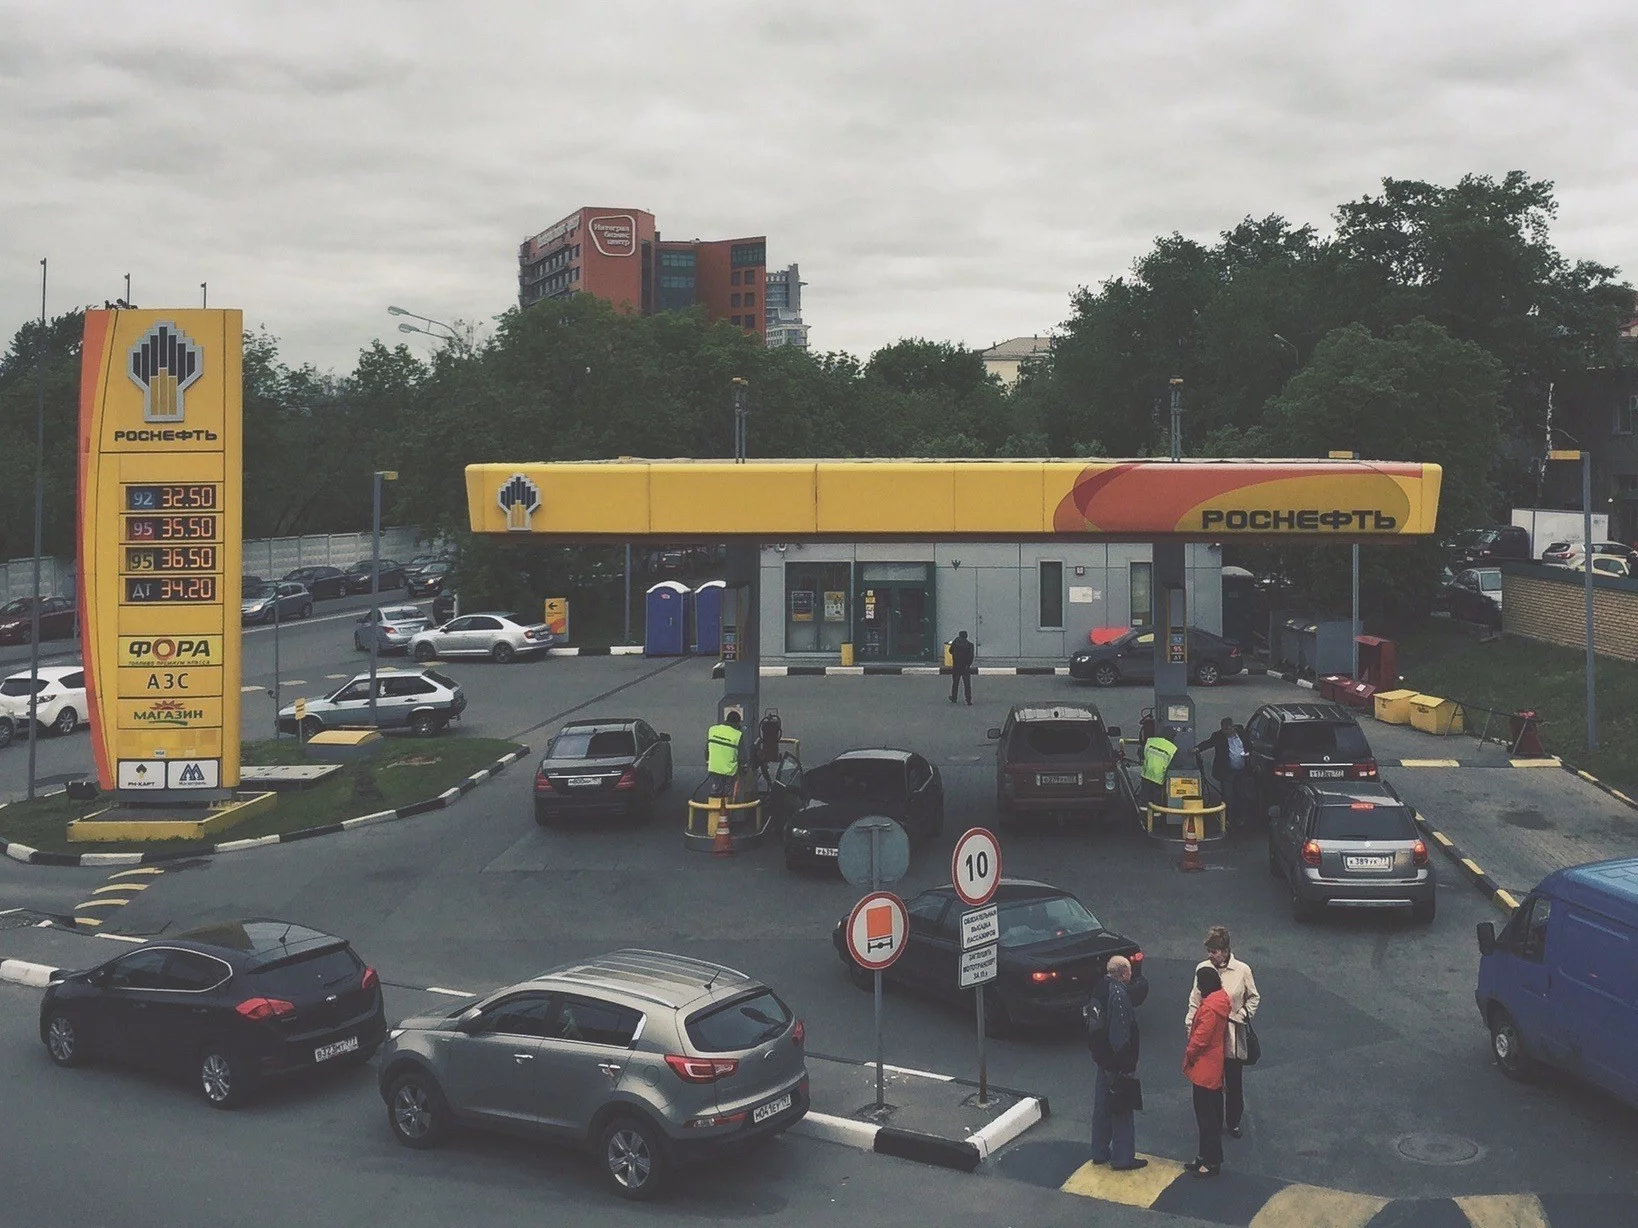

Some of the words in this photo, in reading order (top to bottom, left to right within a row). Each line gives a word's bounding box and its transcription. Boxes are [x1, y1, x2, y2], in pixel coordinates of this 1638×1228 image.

[603, 231, 630, 239] бизнес
[607, 239, 630, 247] центр
[114, 430, 218, 442] РОСНЕФТЬ
[133, 491, 153, 506] 92
[162, 487, 213, 507] 32.50
[133, 522, 153, 536] 95
[162, 518, 212, 538] 35.50
[1202, 509, 1397, 530] РОСНЕФТЬ
[131, 553, 153, 570] 95
[161, 548, 212, 568] 36.50
[161, 579, 212, 599] 34.20
[129, 637, 210, 660] ФОРА
[147, 672, 189, 690] АЗС
[133, 710, 203, 720] МАГАЗИН
[965, 851, 988, 882] 10
